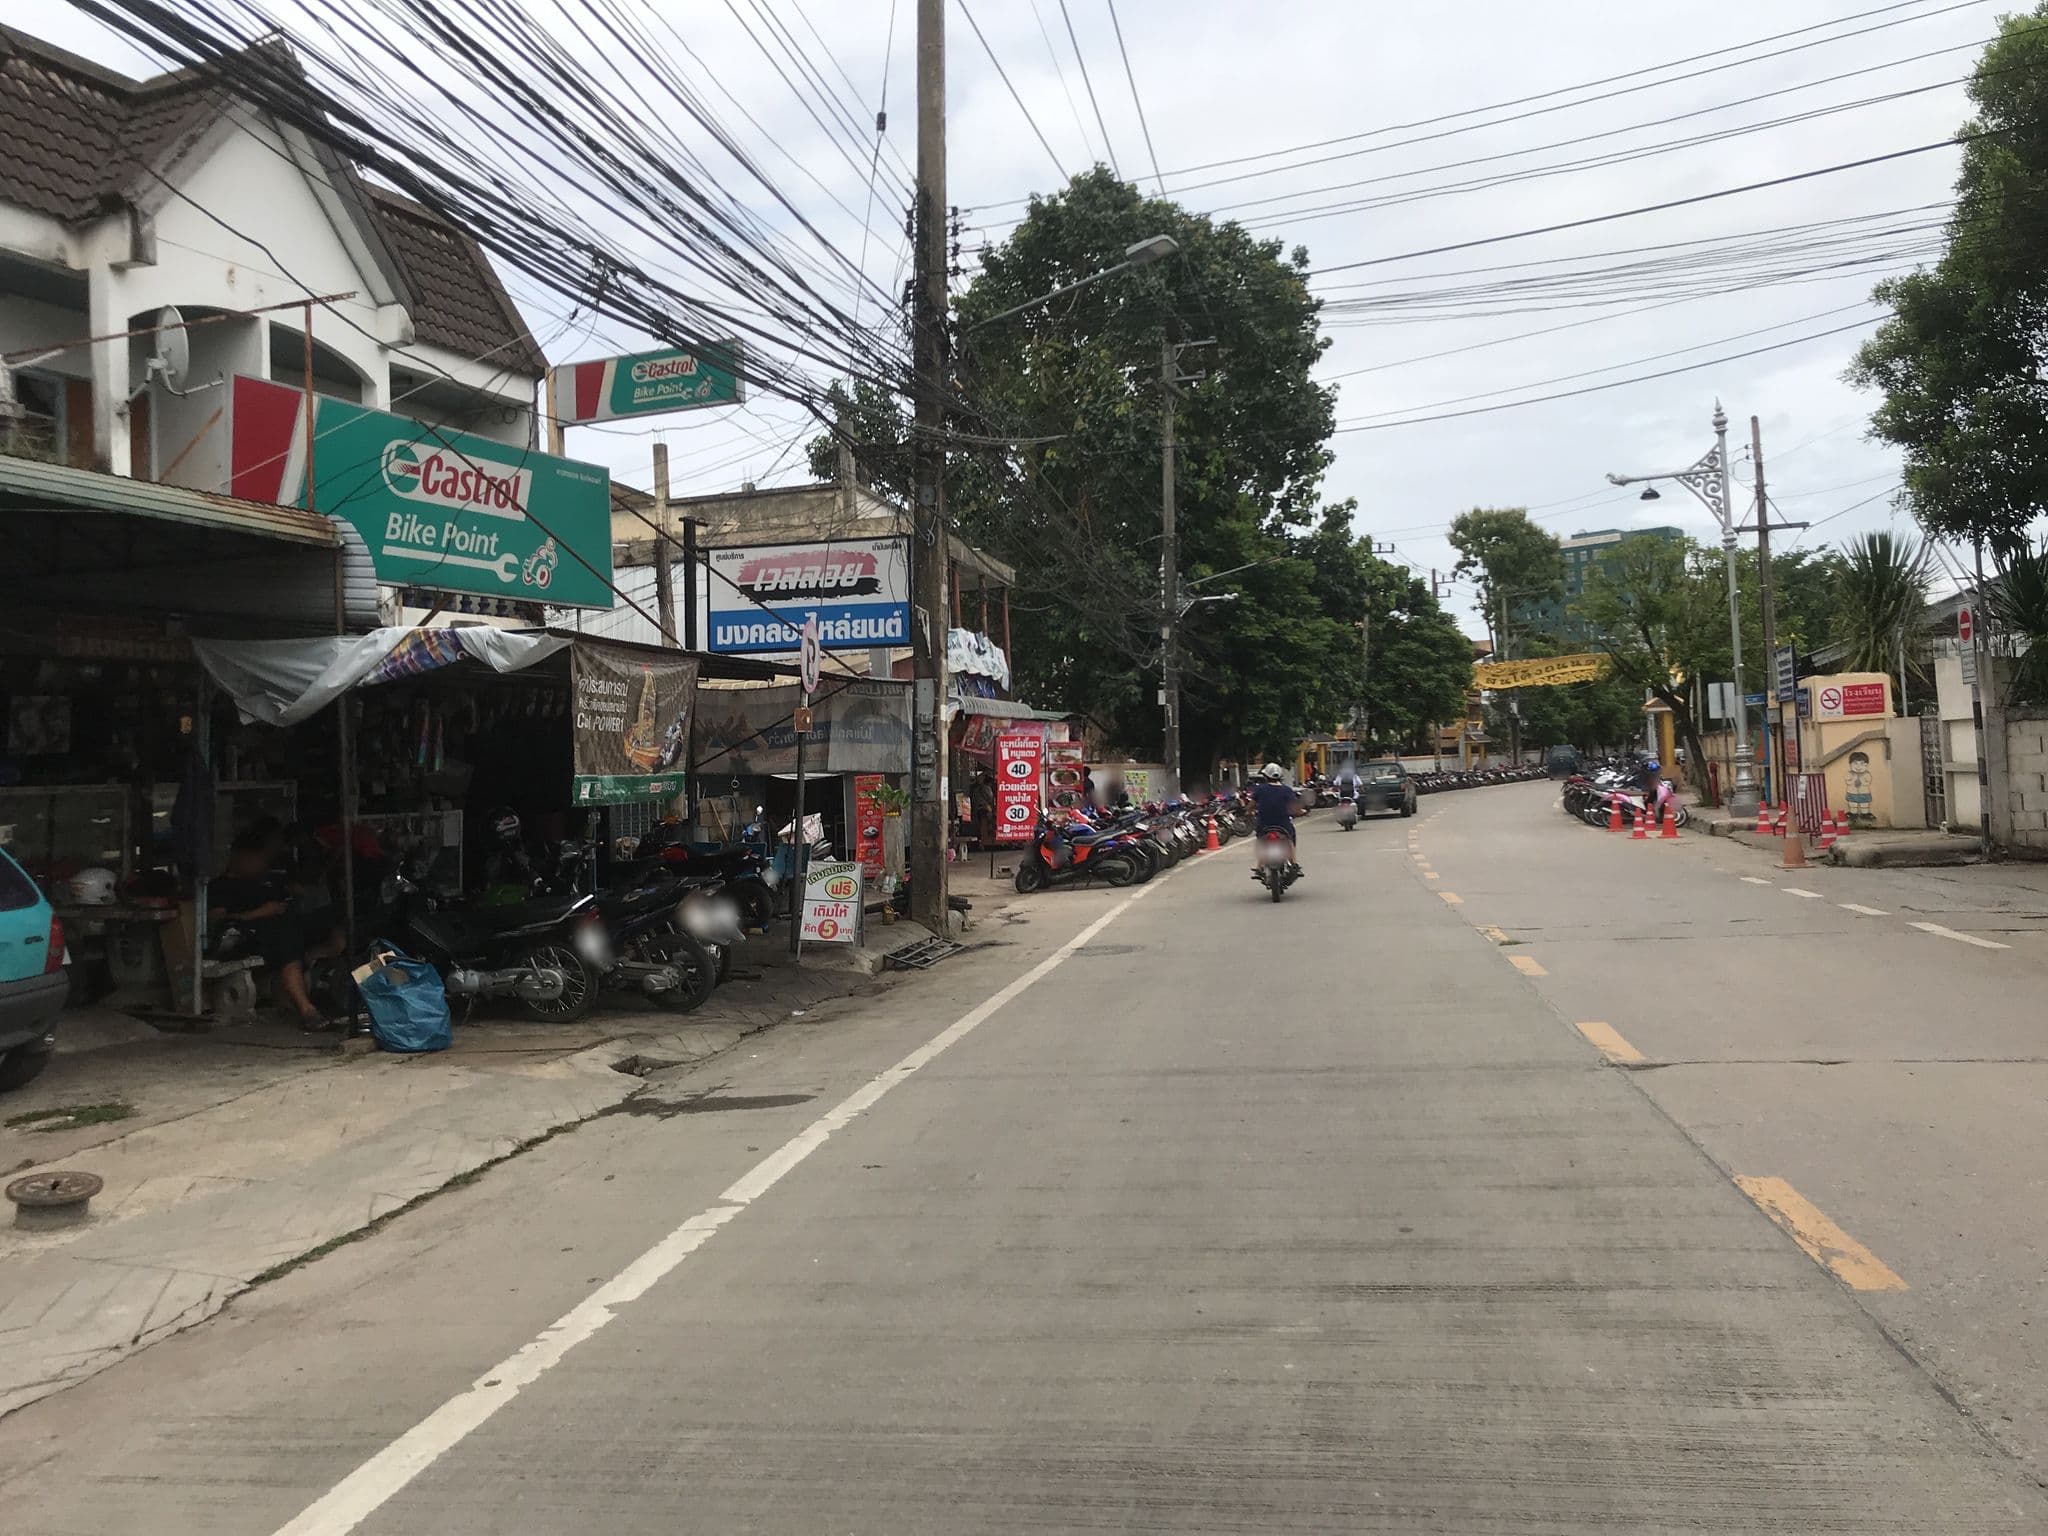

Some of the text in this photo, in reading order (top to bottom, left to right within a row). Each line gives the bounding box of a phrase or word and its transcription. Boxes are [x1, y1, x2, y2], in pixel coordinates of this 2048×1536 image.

[648, 360, 694, 378] Castrol
[634, 382, 684, 398] Bike Point
[422, 454, 521, 511] Castrol
[385, 512, 499, 556] Bike Point
[831, 880, 852, 896] ฟรี
[813, 903, 849, 917] เติมให้
